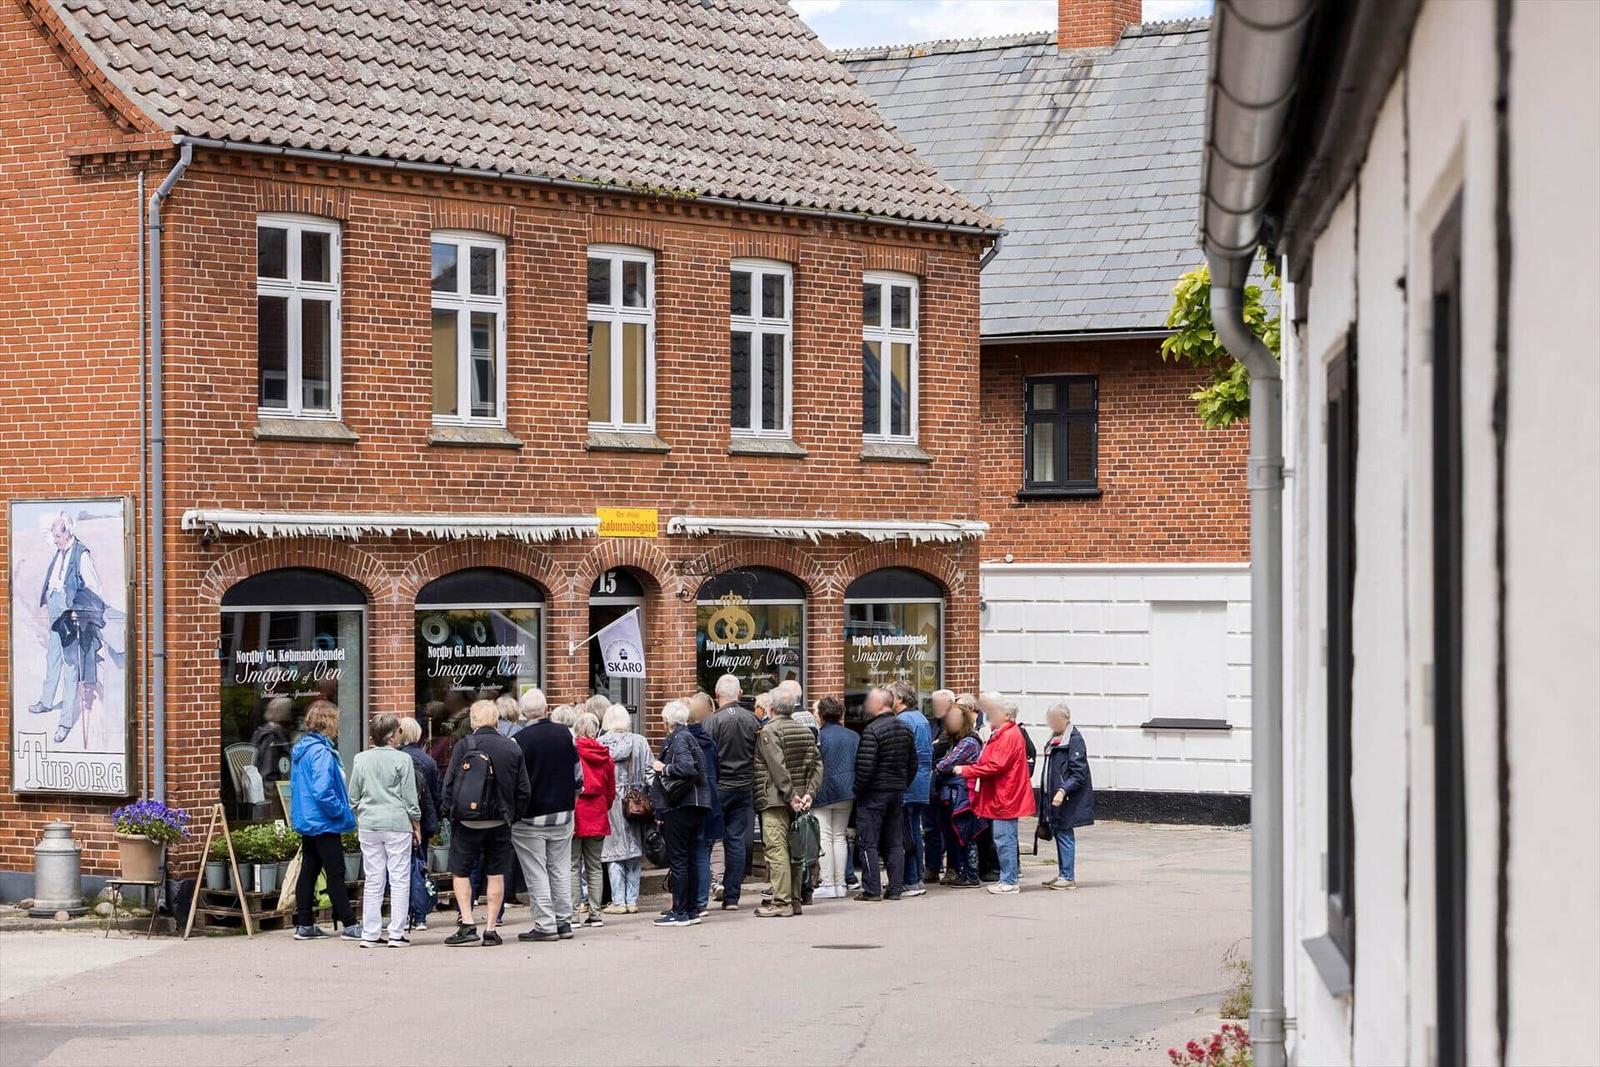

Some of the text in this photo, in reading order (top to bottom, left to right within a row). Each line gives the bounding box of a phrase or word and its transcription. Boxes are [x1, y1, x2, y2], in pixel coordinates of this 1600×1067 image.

[598, 572, 617, 594] 15
[236, 650, 264, 665] Nordby
[428, 646, 453, 659] Nordby
